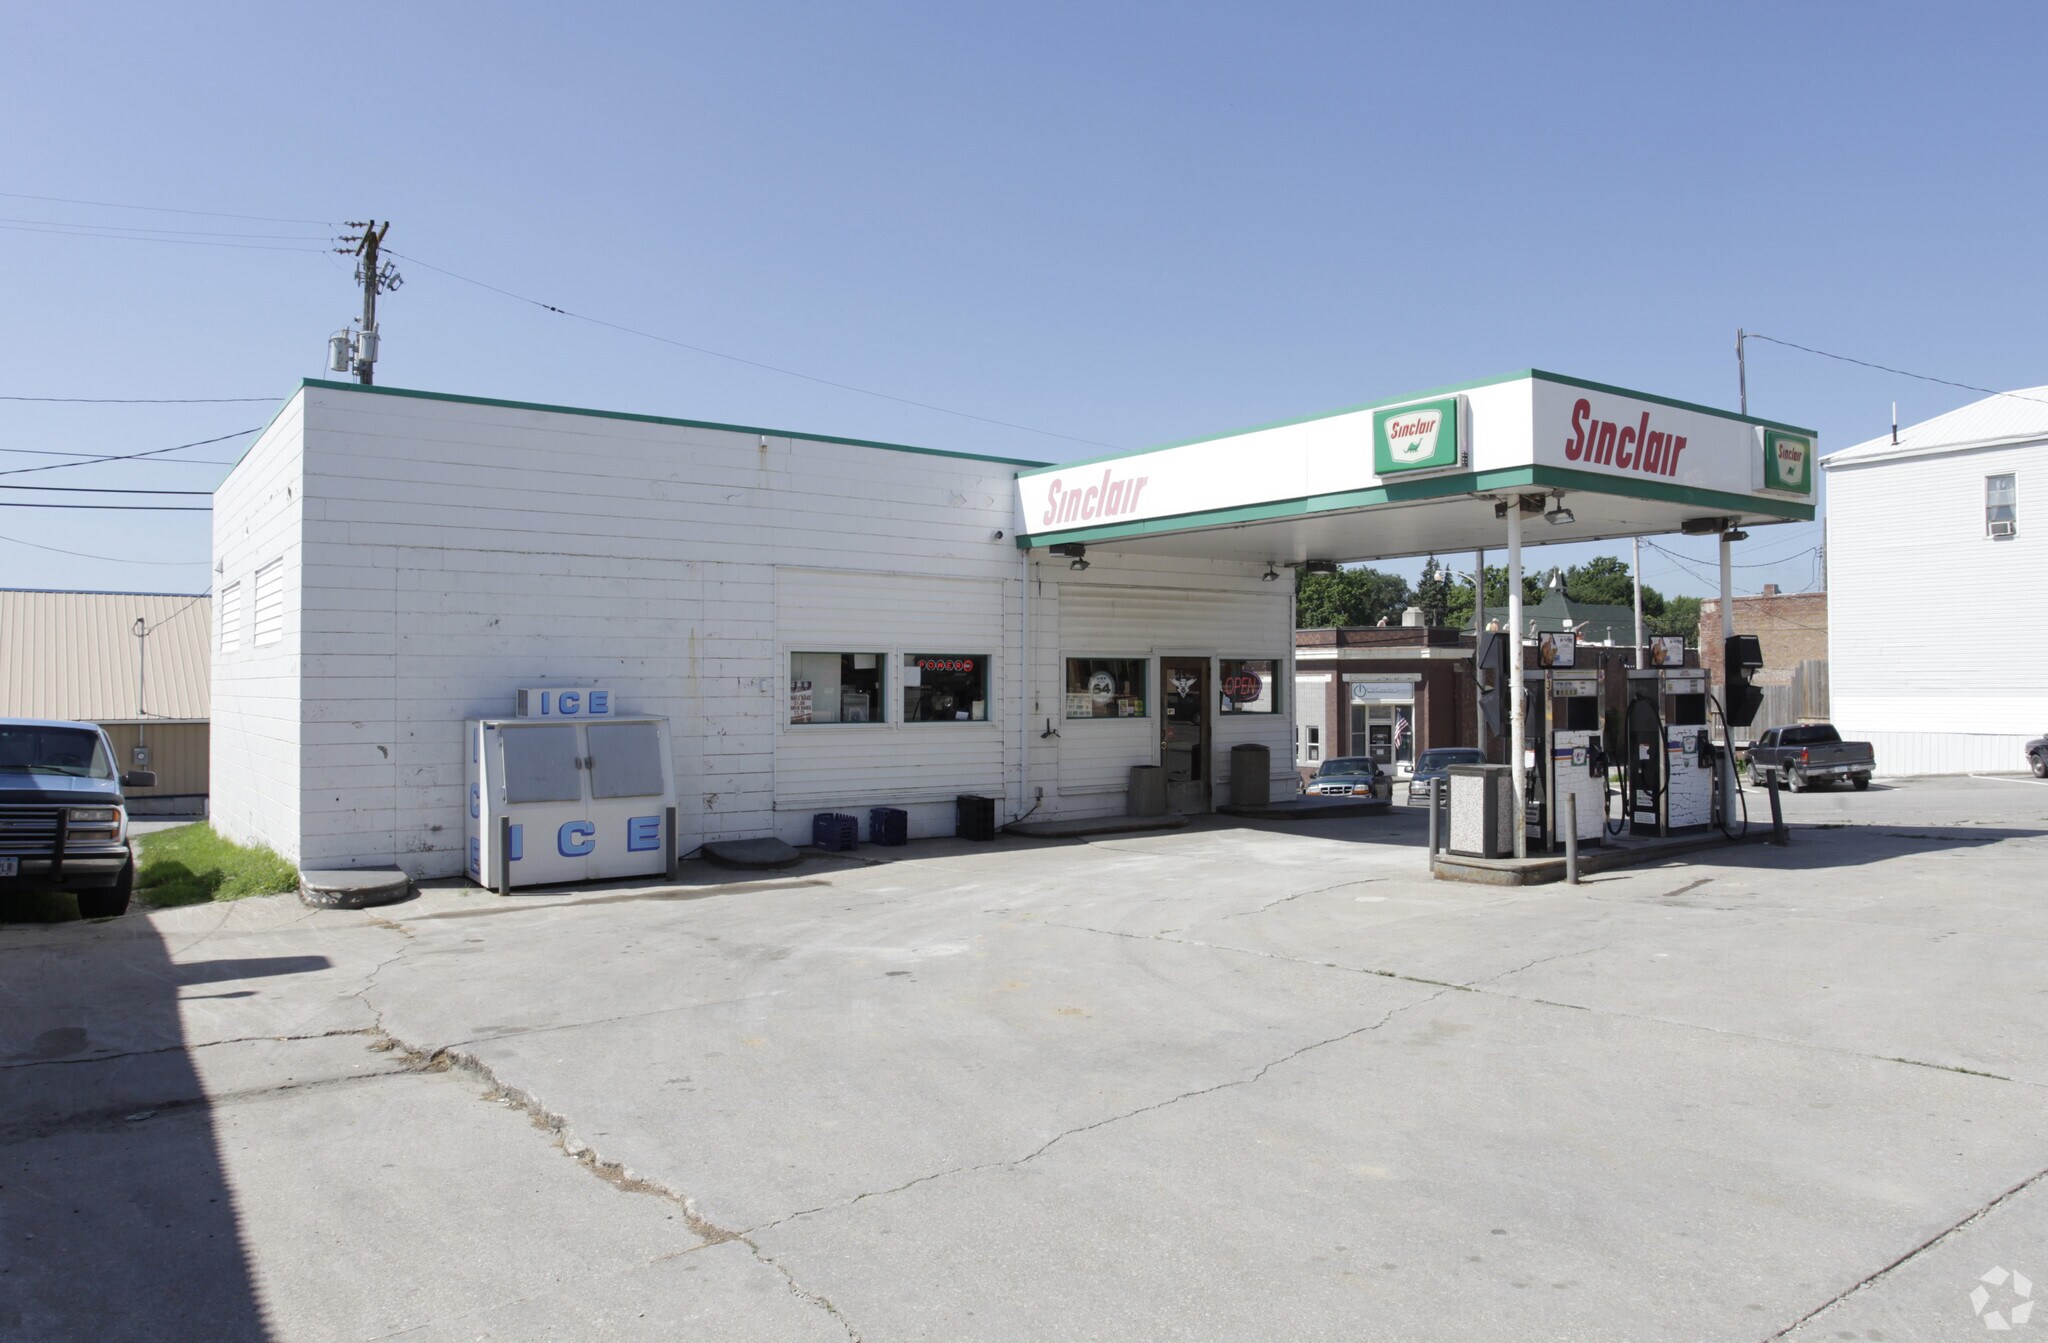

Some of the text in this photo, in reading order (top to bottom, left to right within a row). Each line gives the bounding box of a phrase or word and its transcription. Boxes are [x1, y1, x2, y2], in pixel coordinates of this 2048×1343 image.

[1390, 415, 1437, 440] Sinclair
[1564, 398, 1688, 477] Sinclair
[1777, 442, 1804, 463] Sinclair
[1043, 468, 1149, 527] Sinclair
[918, 660, 963, 671] POWER
[1225, 676, 1256, 695] OPEN
[541, 691, 609, 715] ICE
[470, 727, 481, 875] ICE
[509, 815, 661, 862] ICE
